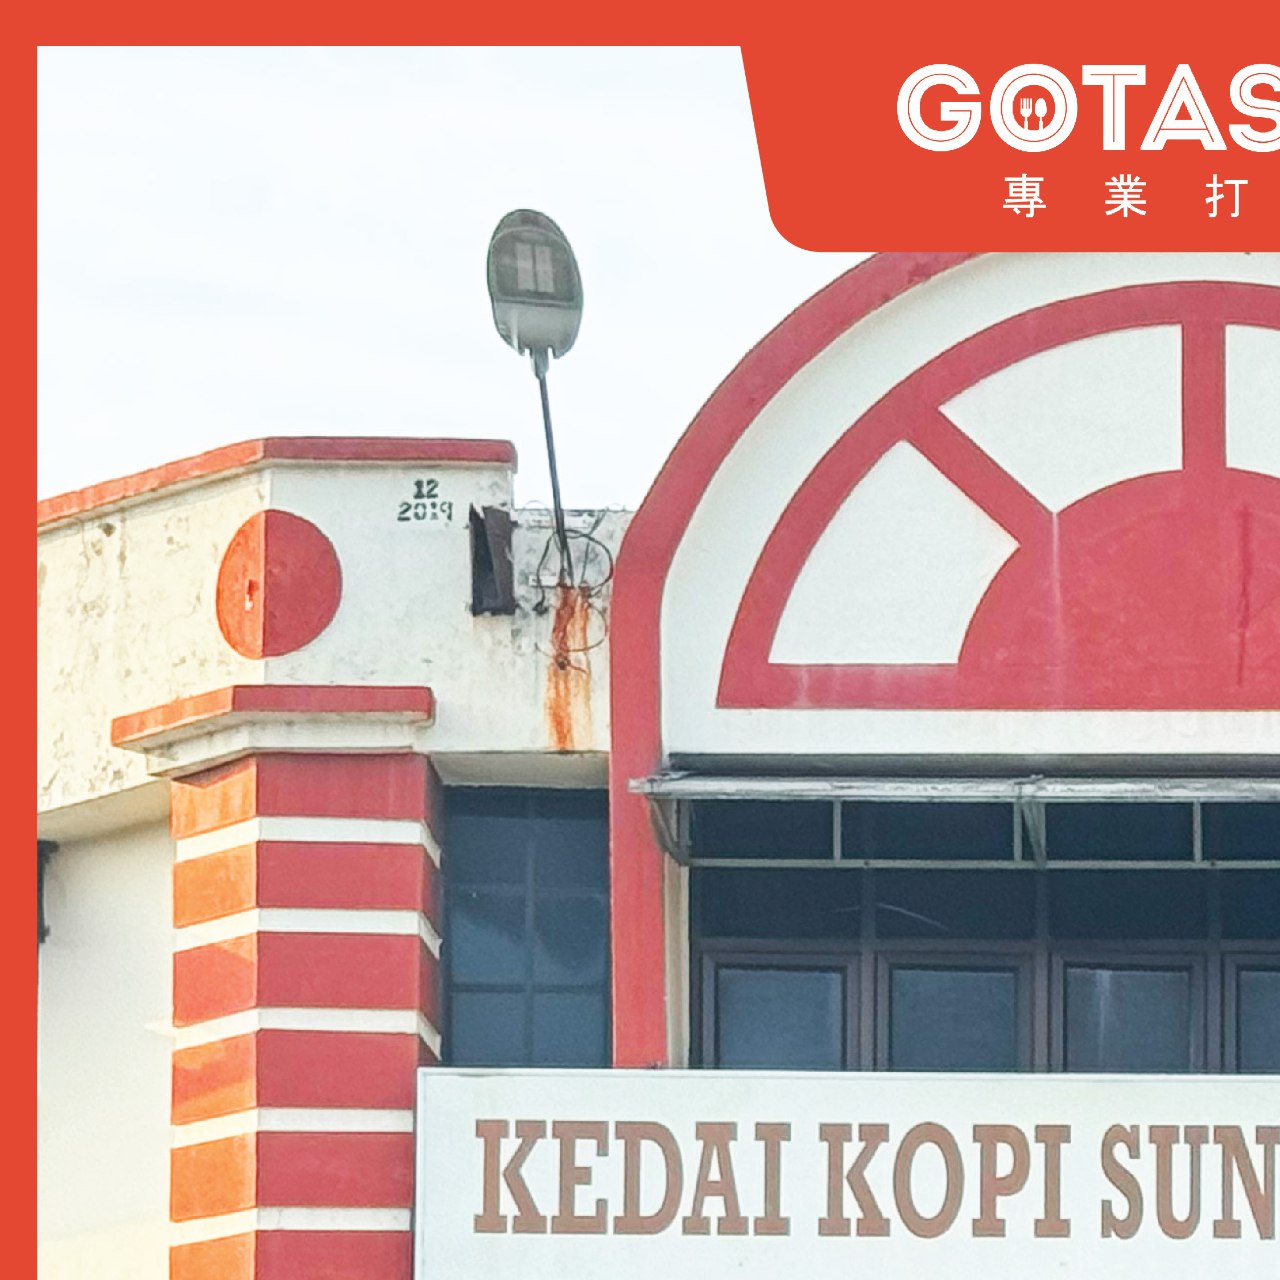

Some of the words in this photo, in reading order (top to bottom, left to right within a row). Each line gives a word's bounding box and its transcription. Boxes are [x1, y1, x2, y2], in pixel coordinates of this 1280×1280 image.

[413, 478, 439, 499] 12
[397, 501, 453, 522] 2019
[473, 1119, 792, 1238] KEDAI
[818, 1121, 1072, 1239] KOPI
